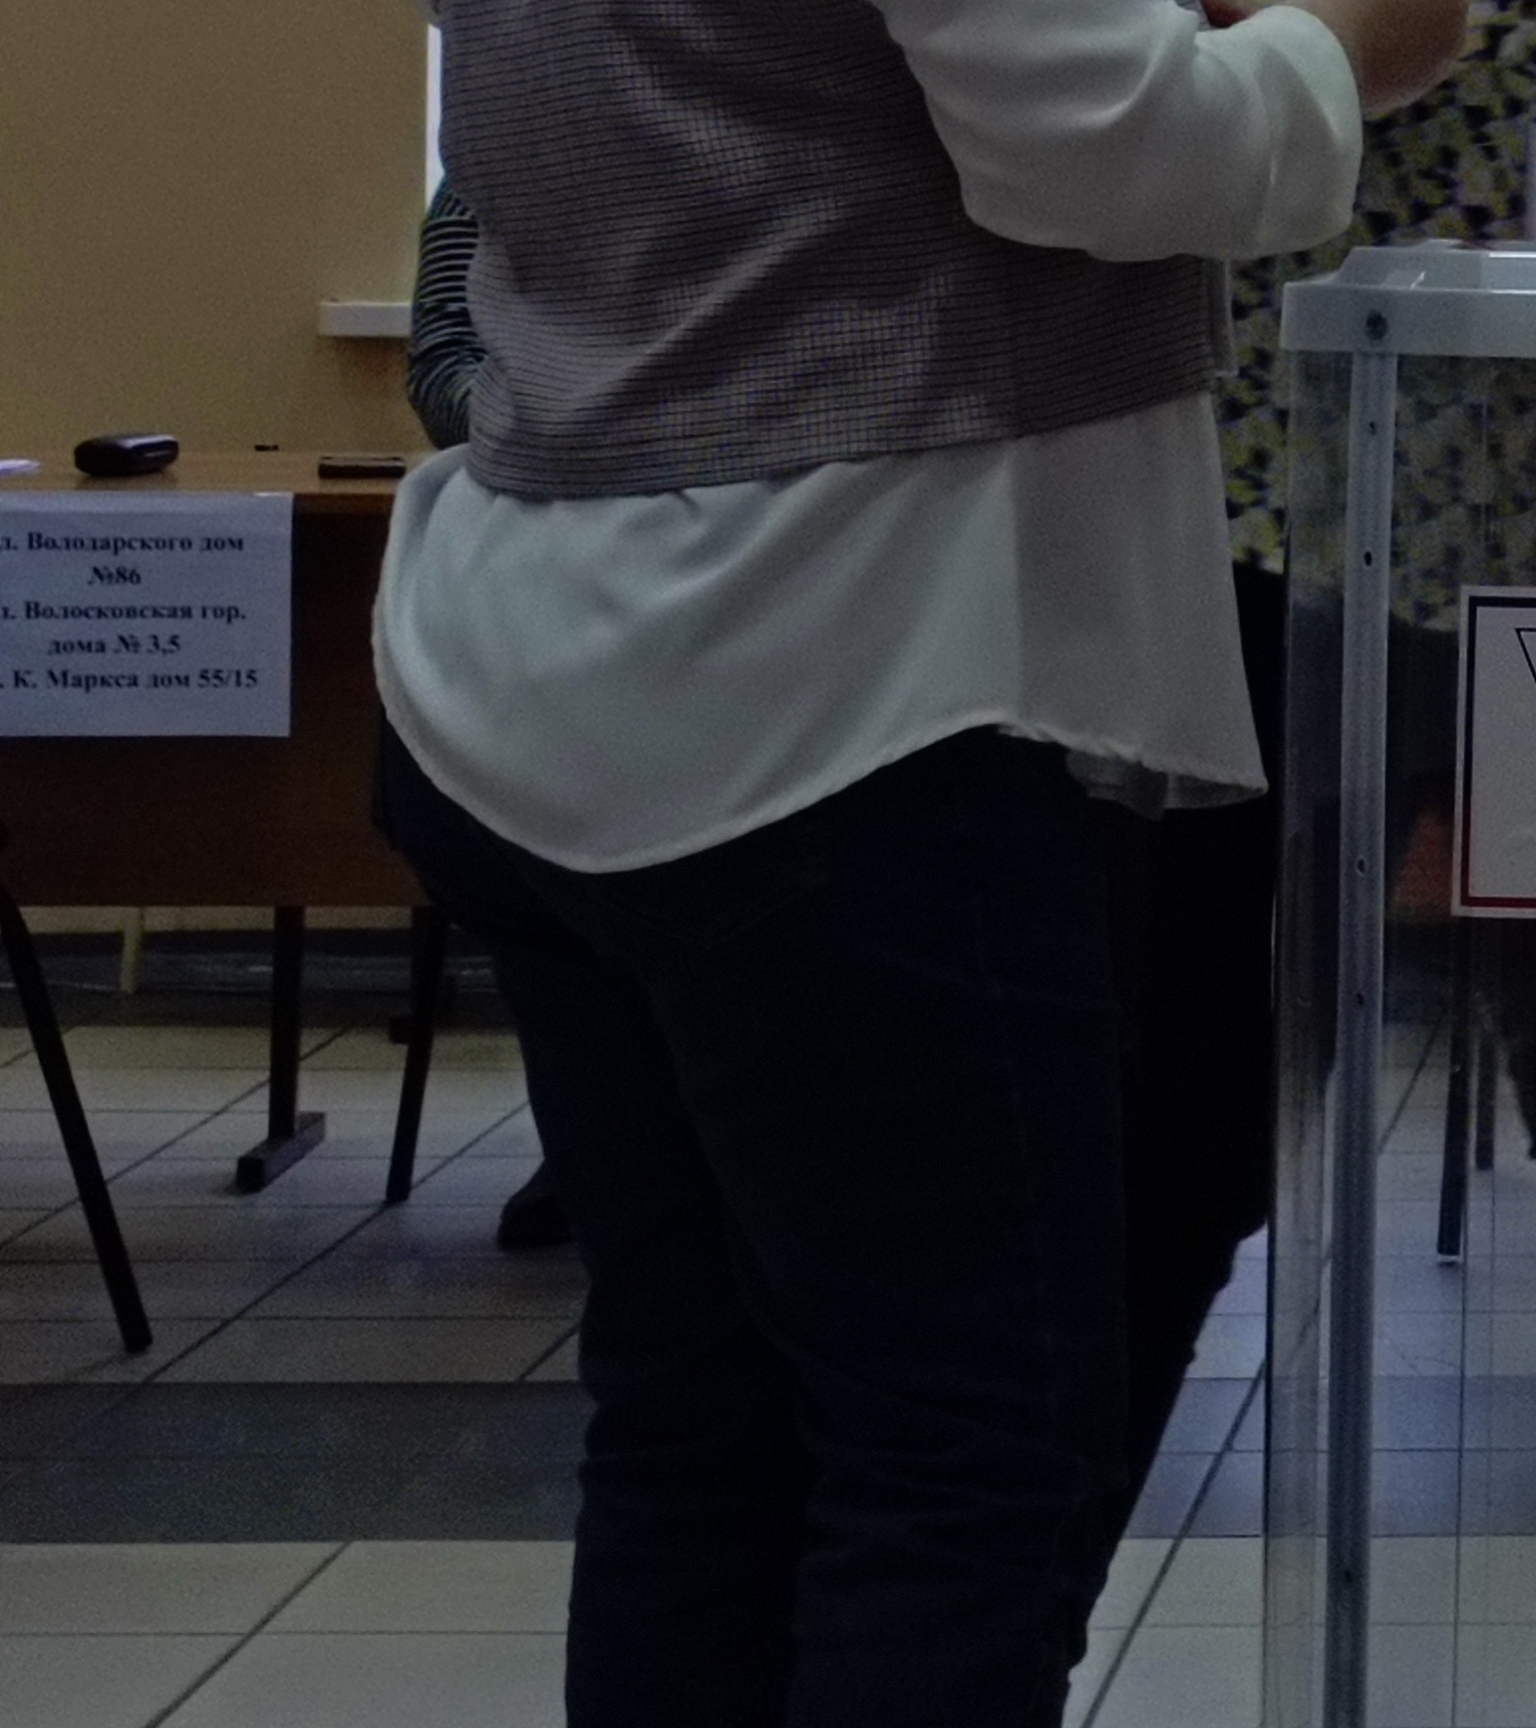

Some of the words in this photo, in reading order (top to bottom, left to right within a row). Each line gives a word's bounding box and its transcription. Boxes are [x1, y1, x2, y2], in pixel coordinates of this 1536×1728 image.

[27, 531, 193, 556] Володарского
[199, 536, 244, 552] дом
[87, 566, 142, 586] №86
[24, 600, 194, 620] Волосковская
[200, 605, 247, 624] гор.
[47, 640, 107, 657] дома
[113, 634, 140, 655] №
[147, 633, 181, 656] 3,5
[13, 669, 38, 689] К.
[46, 669, 139, 694] Маркса
[144, 674, 190, 691] дом
[197, 668, 258, 689] 55/15
